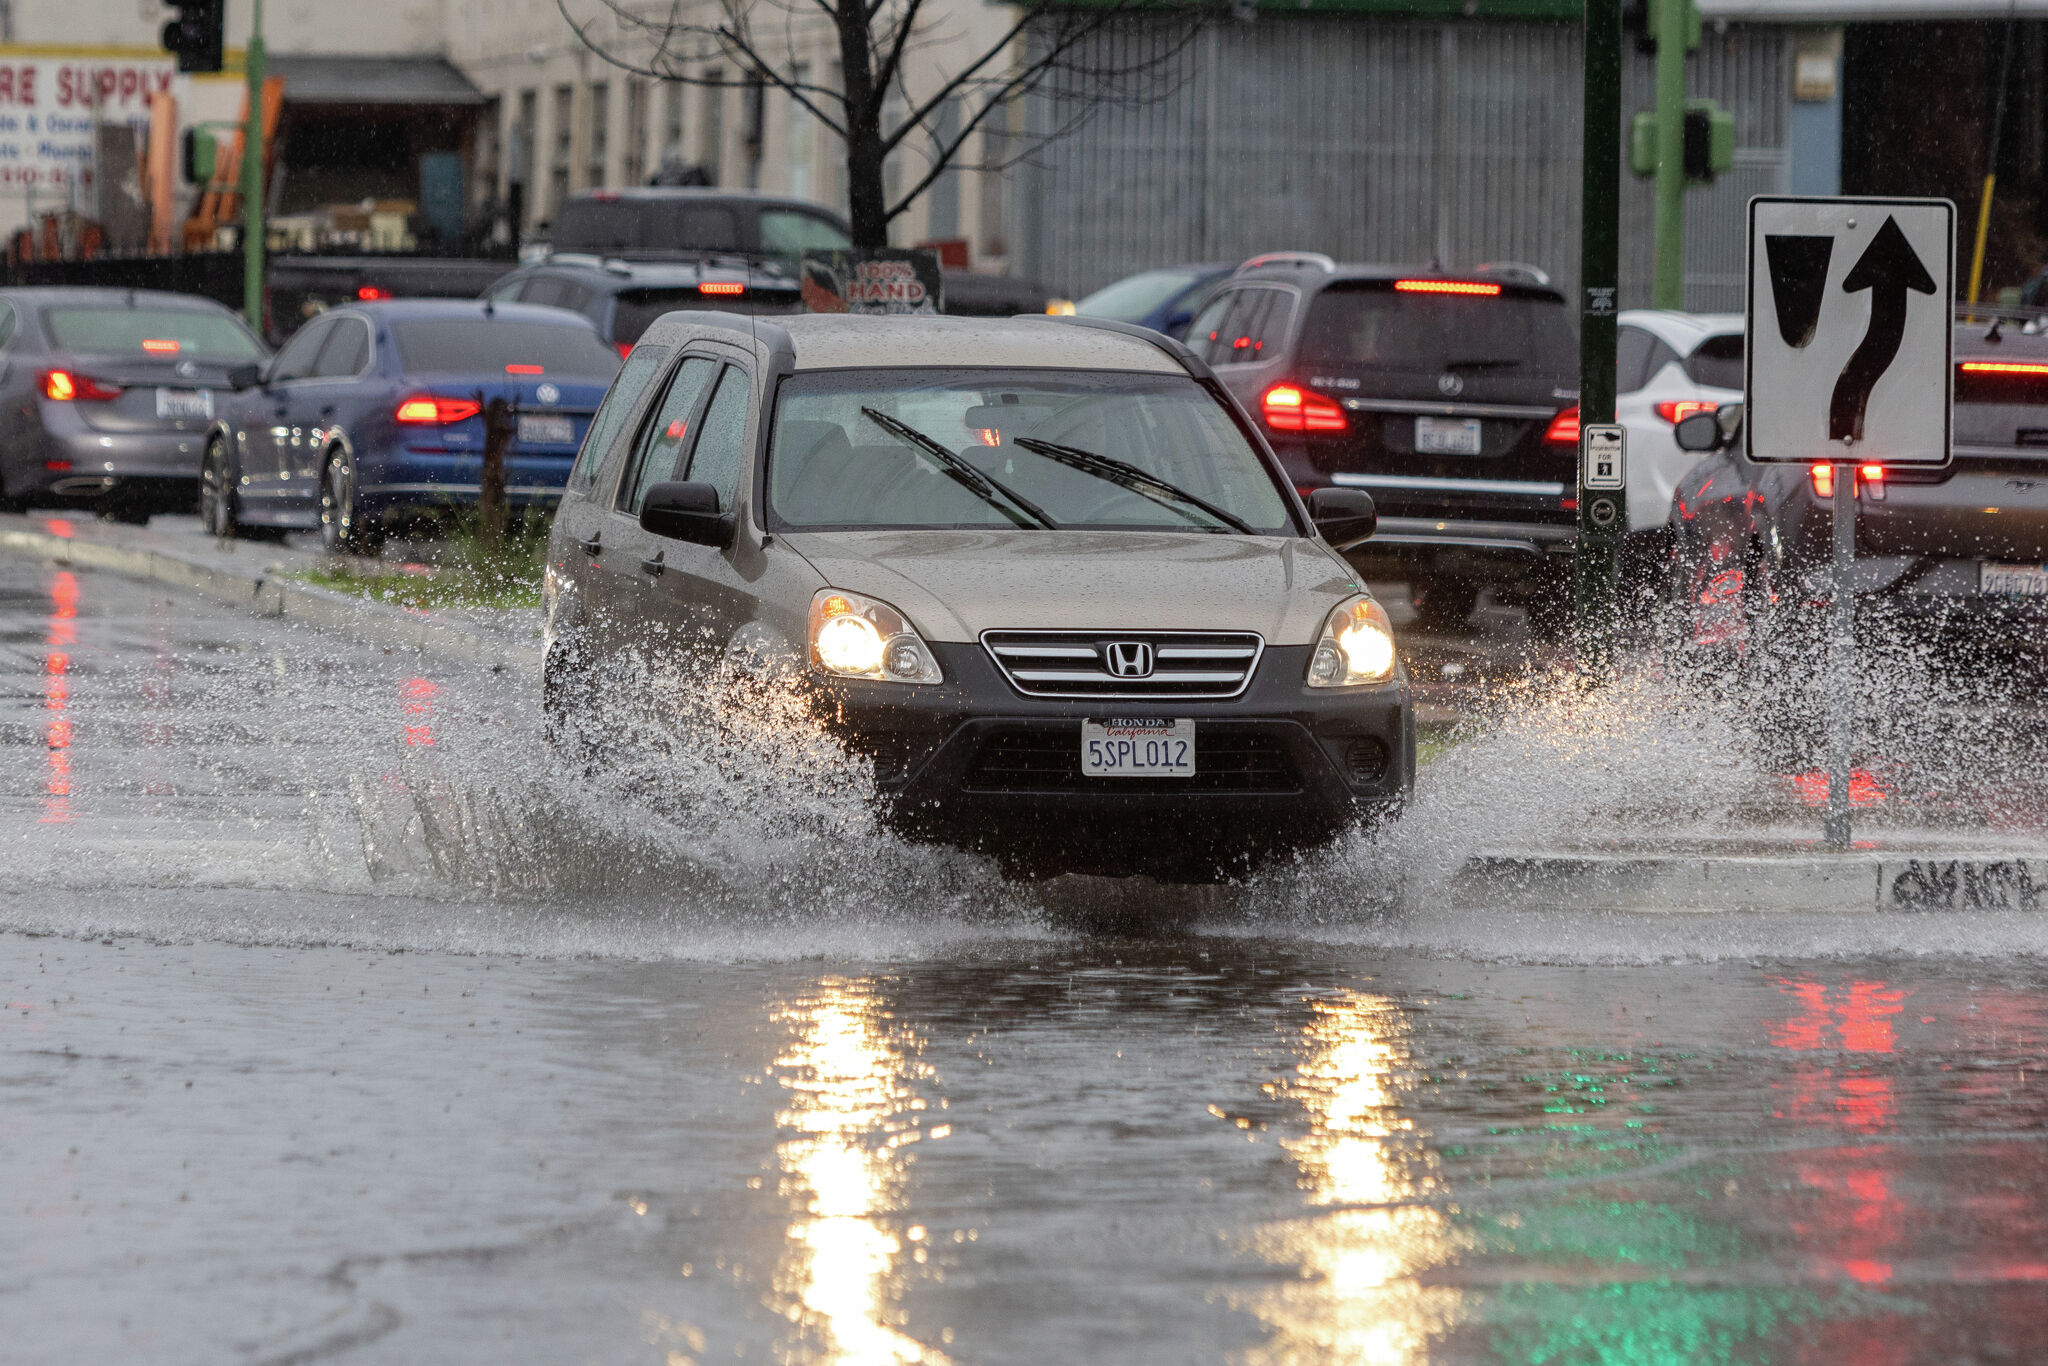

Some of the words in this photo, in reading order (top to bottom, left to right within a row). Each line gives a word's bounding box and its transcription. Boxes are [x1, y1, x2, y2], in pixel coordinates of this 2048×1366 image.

[57, 66, 171, 107] SUPPLY
[857, 261, 912, 278] 100%
[848, 282, 923, 298] HAND
[1111, 718, 1166, 727] HONDA
[1106, 727, 1175, 740] California
[1089, 740, 1189, 768] 5SPL012
